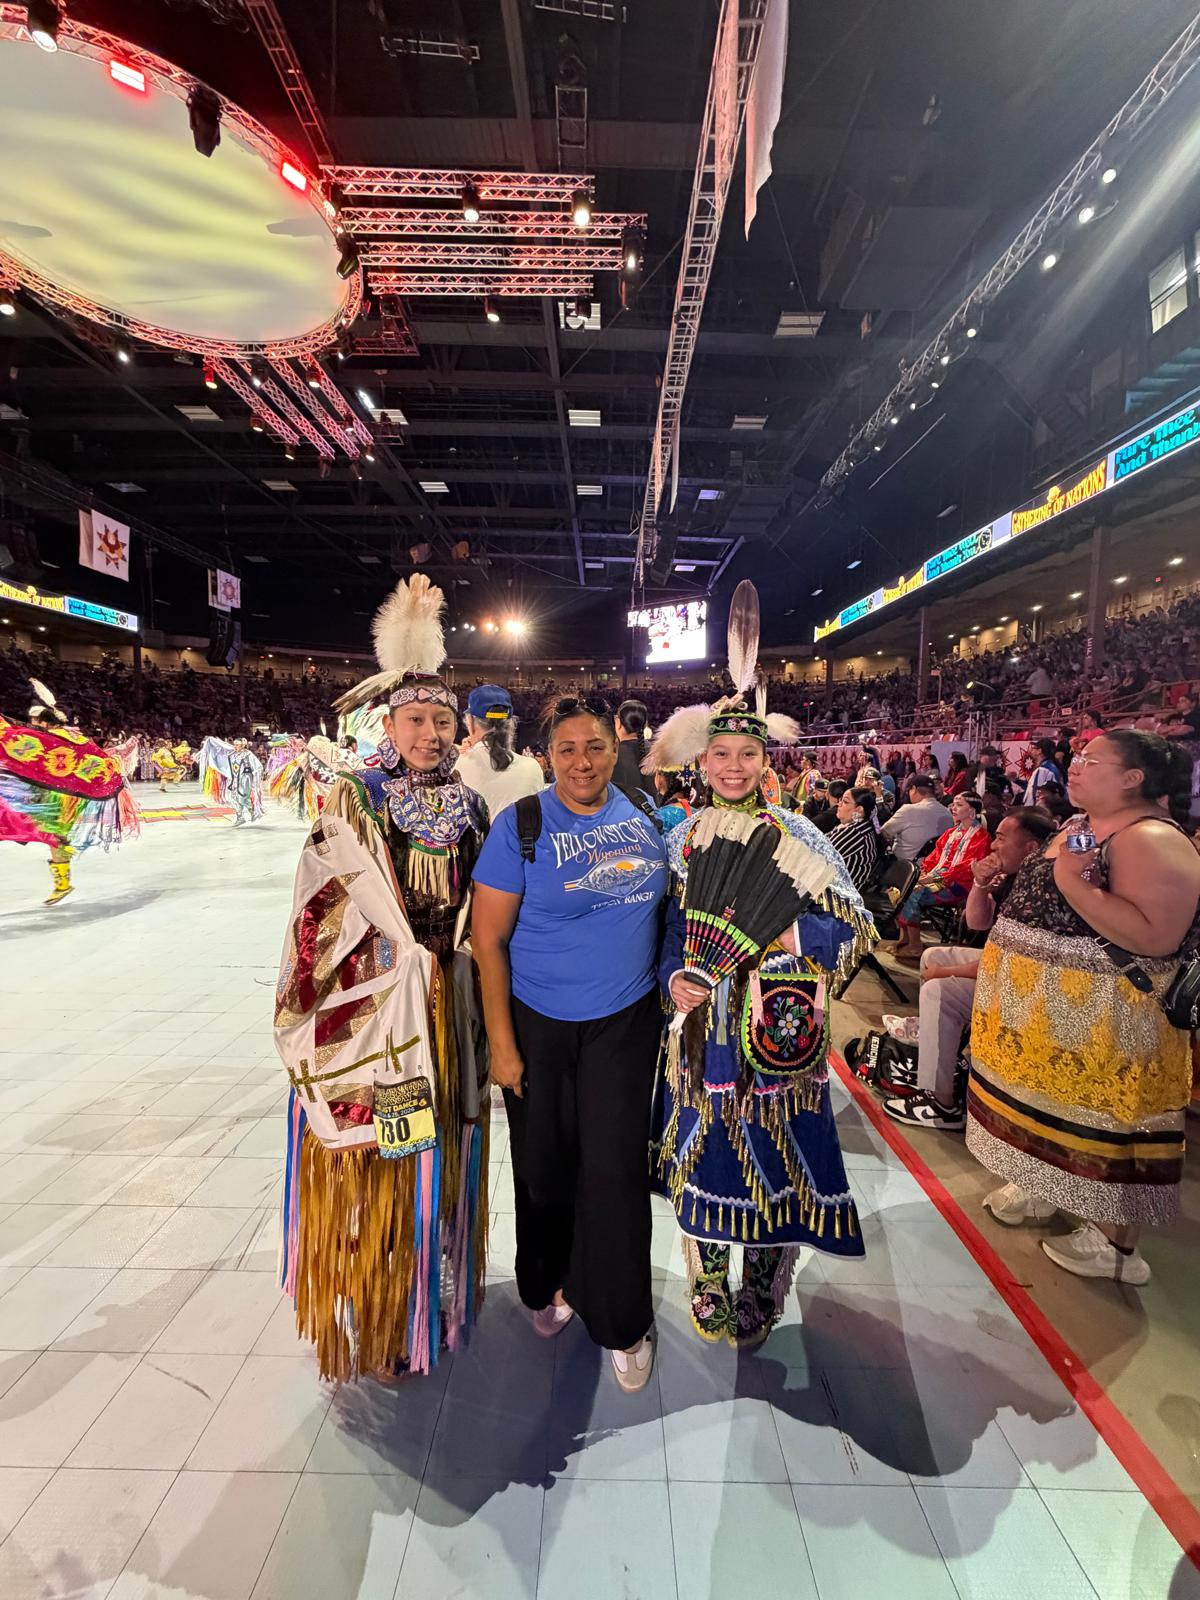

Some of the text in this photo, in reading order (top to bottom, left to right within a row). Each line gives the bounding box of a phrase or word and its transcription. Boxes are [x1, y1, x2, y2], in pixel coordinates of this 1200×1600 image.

[1115, 451, 1147, 480] And
[1012, 458, 1106, 536] GATHERING OF NATIONS
[575, 843, 643, 865] Wyoming
[393, 1099, 418, 1112] DANCE
[379, 1117, 411, 1145] 730
